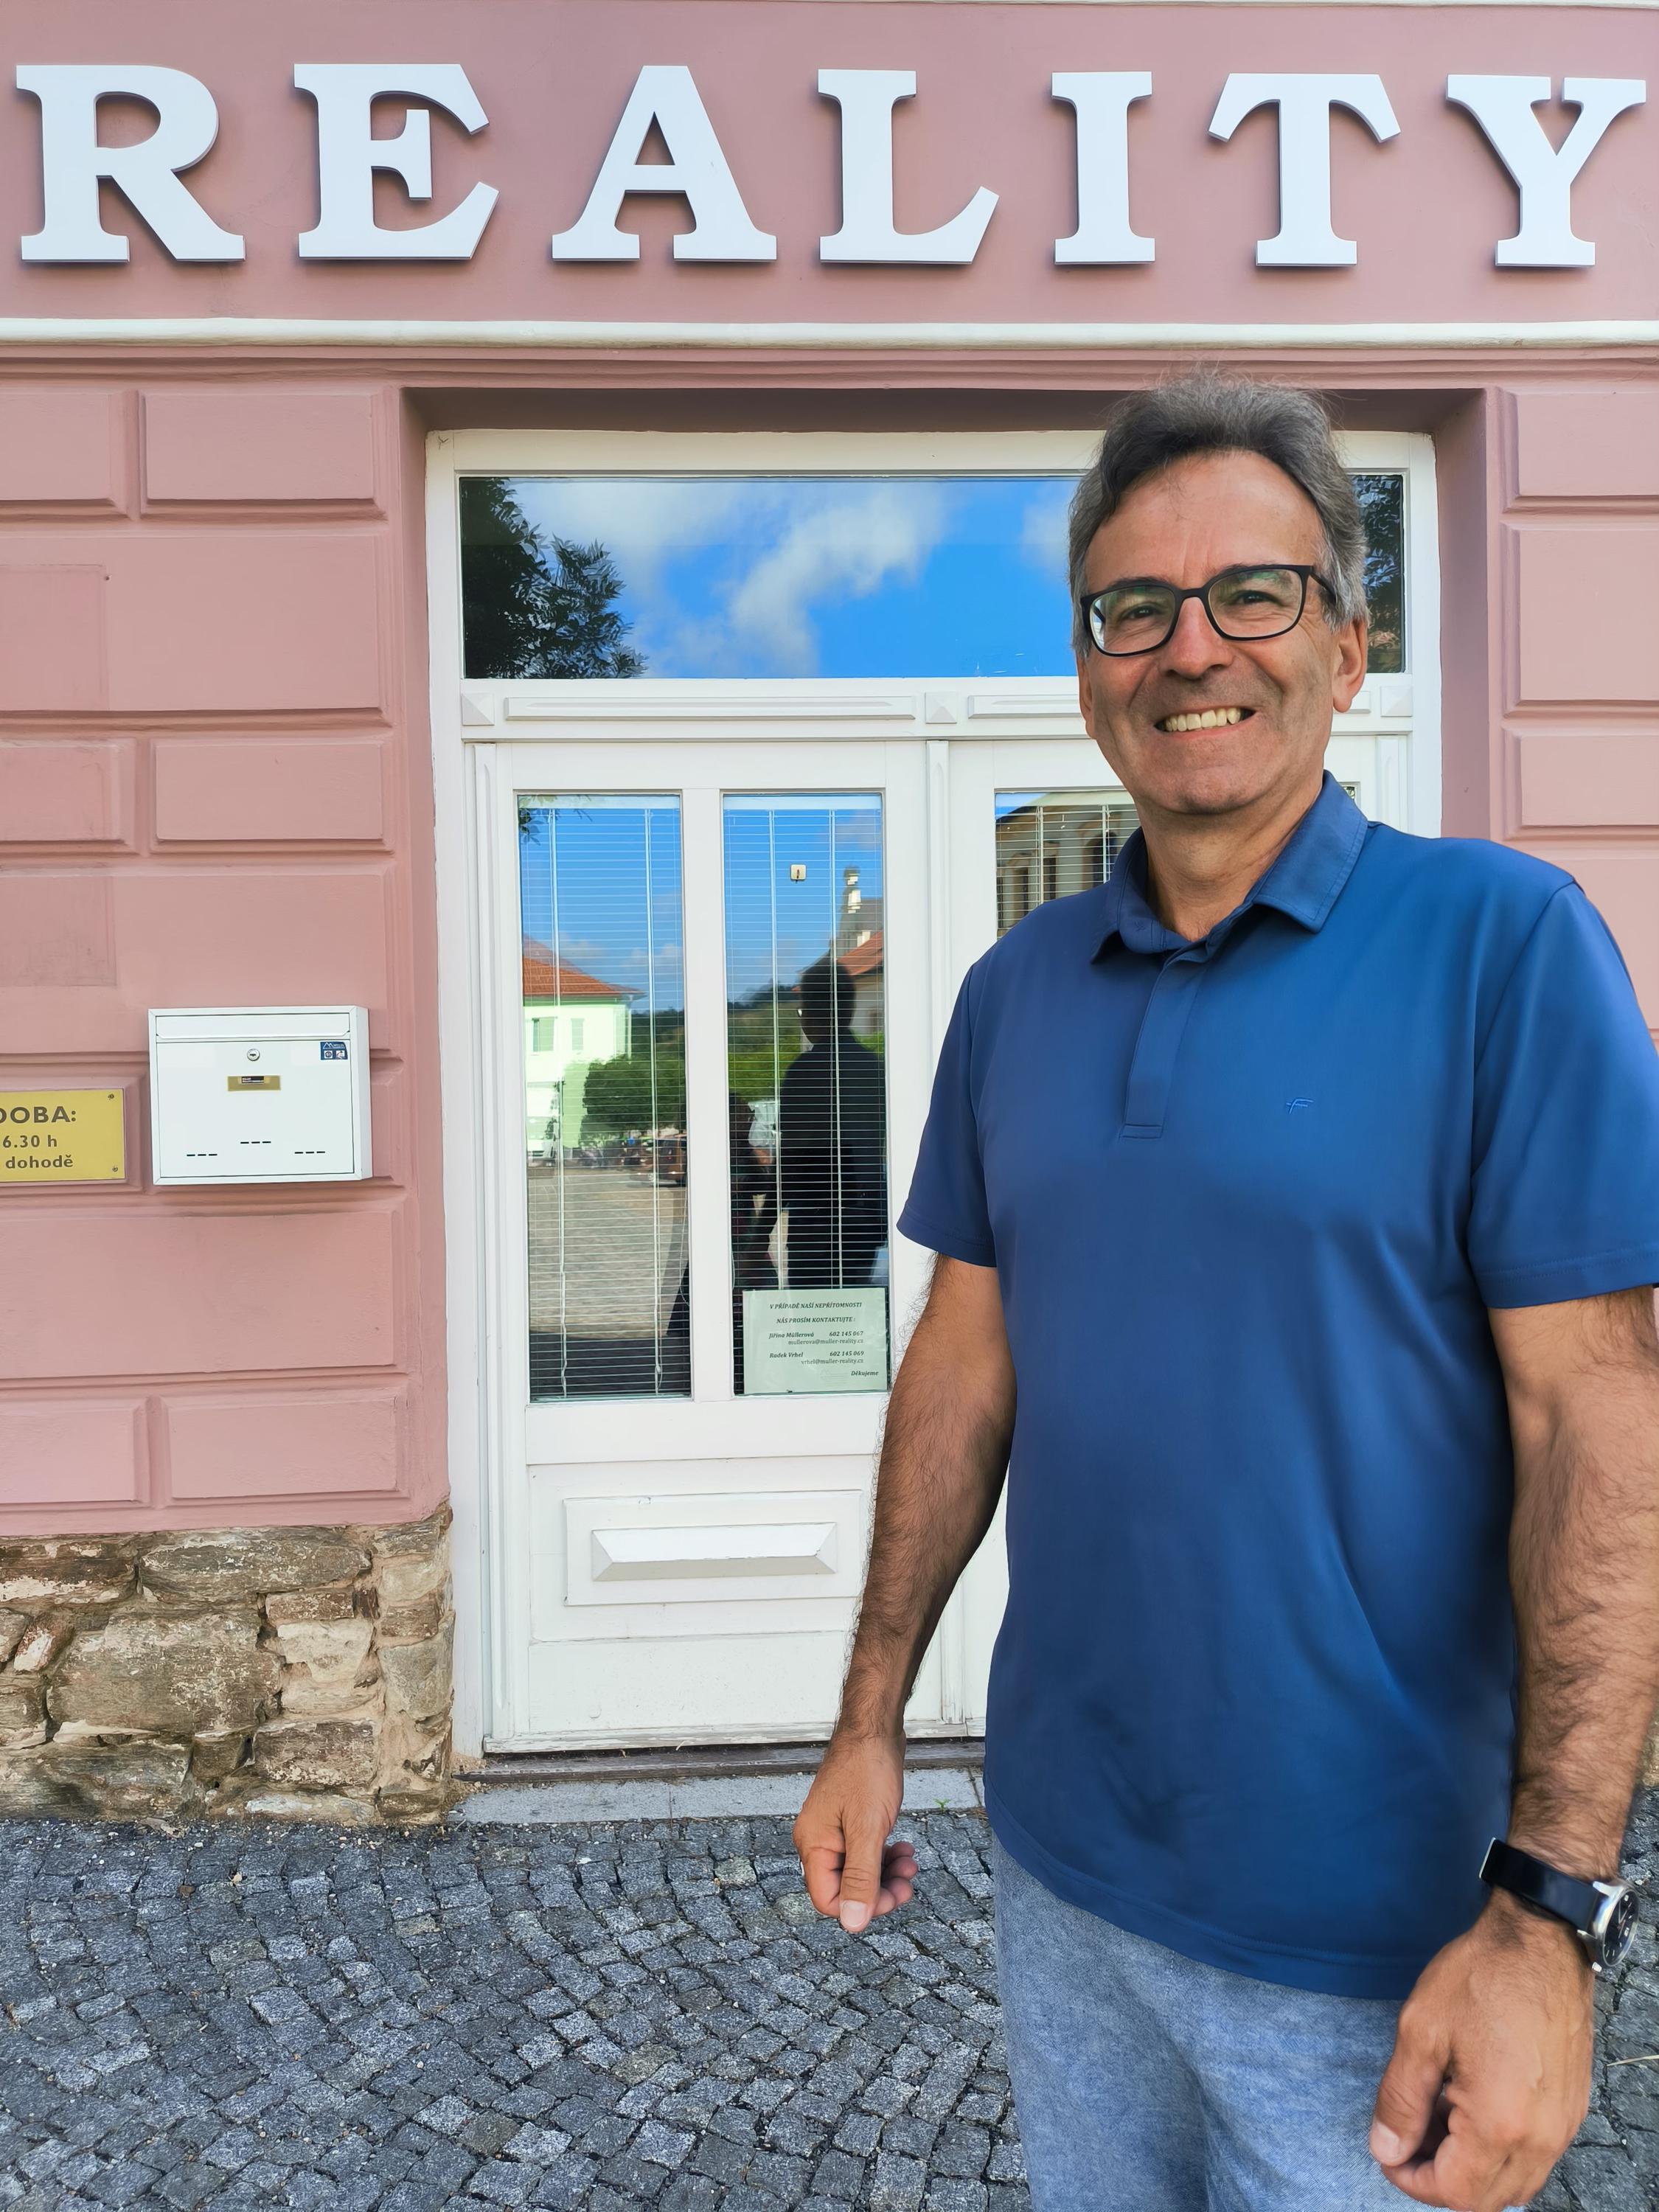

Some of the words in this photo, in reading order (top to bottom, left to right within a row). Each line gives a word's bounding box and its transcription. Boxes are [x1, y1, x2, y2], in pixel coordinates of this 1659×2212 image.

[15, 63, 1648, 268] REALITY
[47, 1134, 58, 1147] h
[5, 1154, 74, 1169] dohodě
